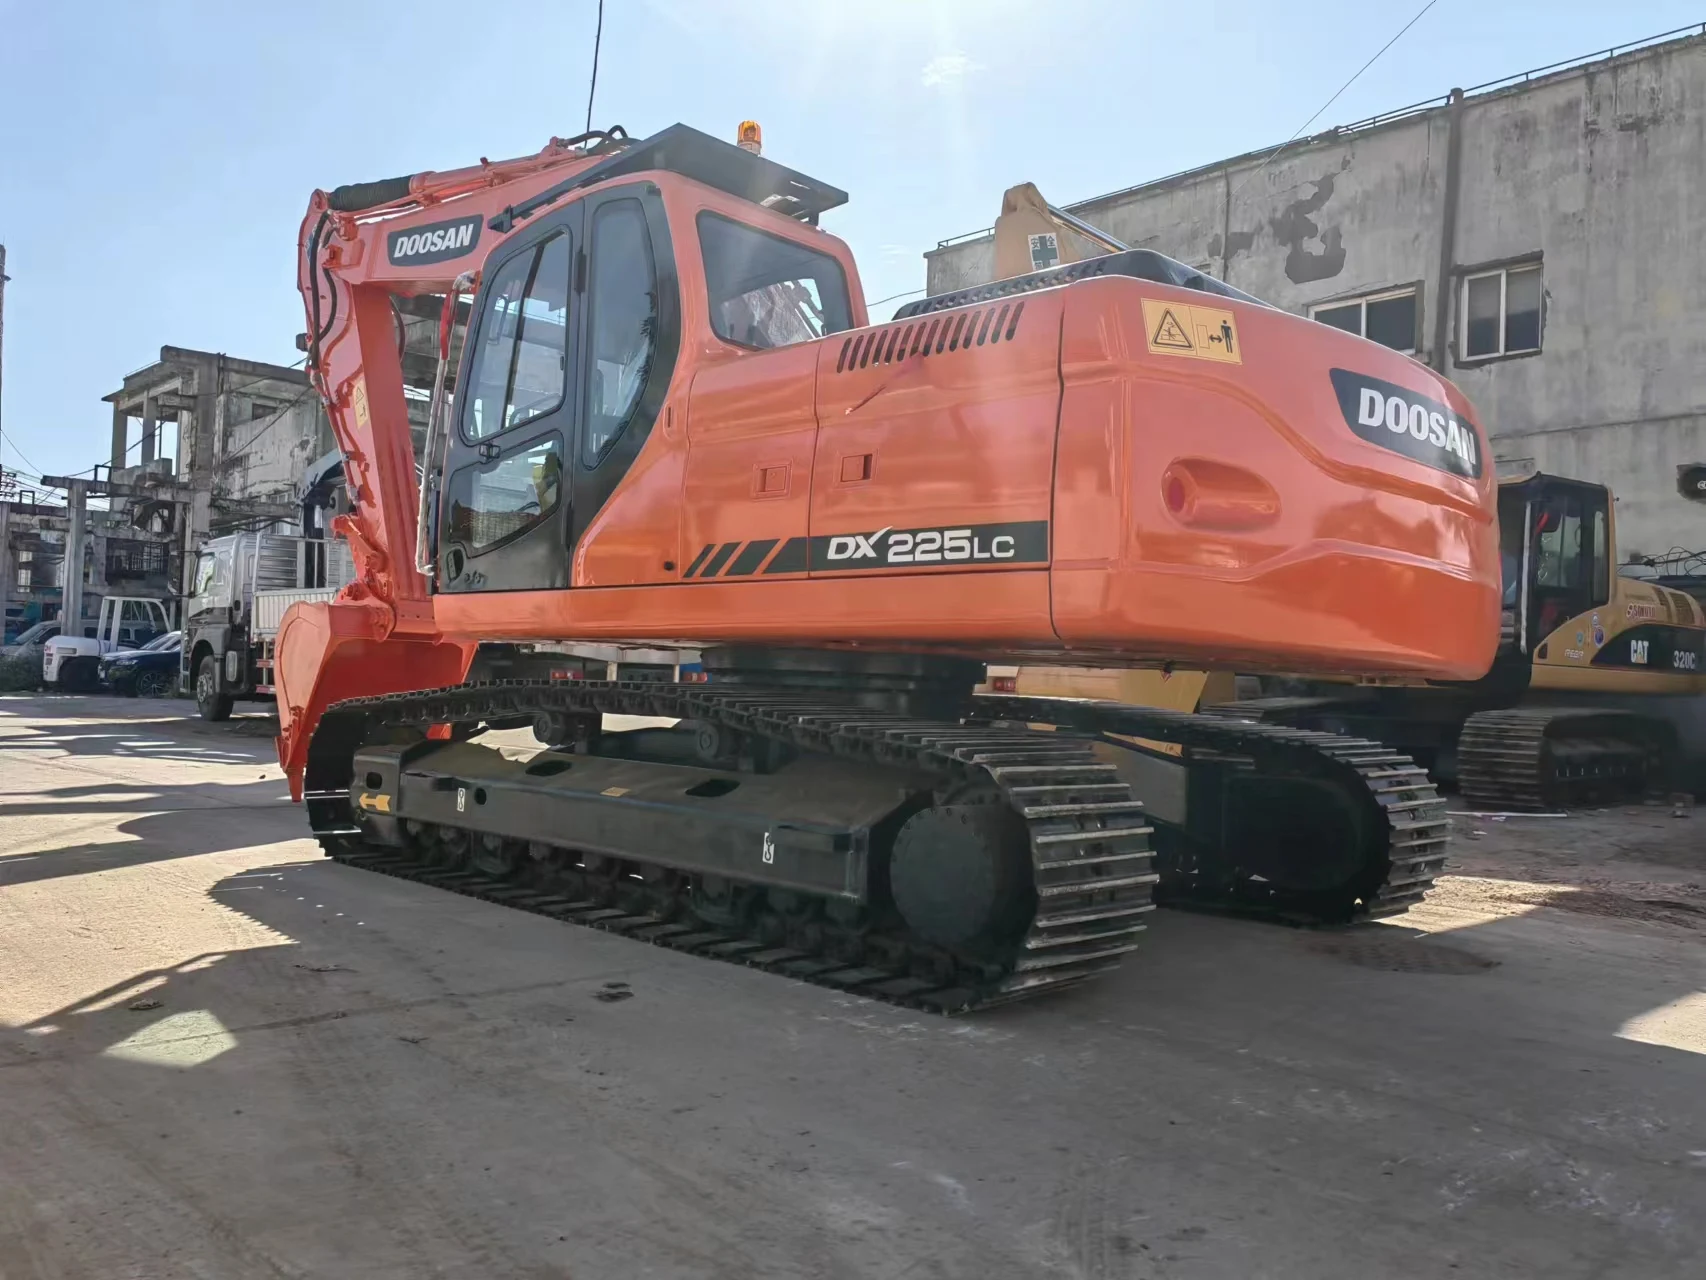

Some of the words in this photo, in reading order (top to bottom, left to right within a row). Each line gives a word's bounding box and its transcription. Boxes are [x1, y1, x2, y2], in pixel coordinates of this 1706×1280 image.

[393, 223, 474, 258] DOOSAN
[1358, 387, 1476, 465] DOOSAN
[827, 525, 893, 560] DX
[1630, 639, 1649, 664] CAT
[1673, 650, 1696, 670] 320C
